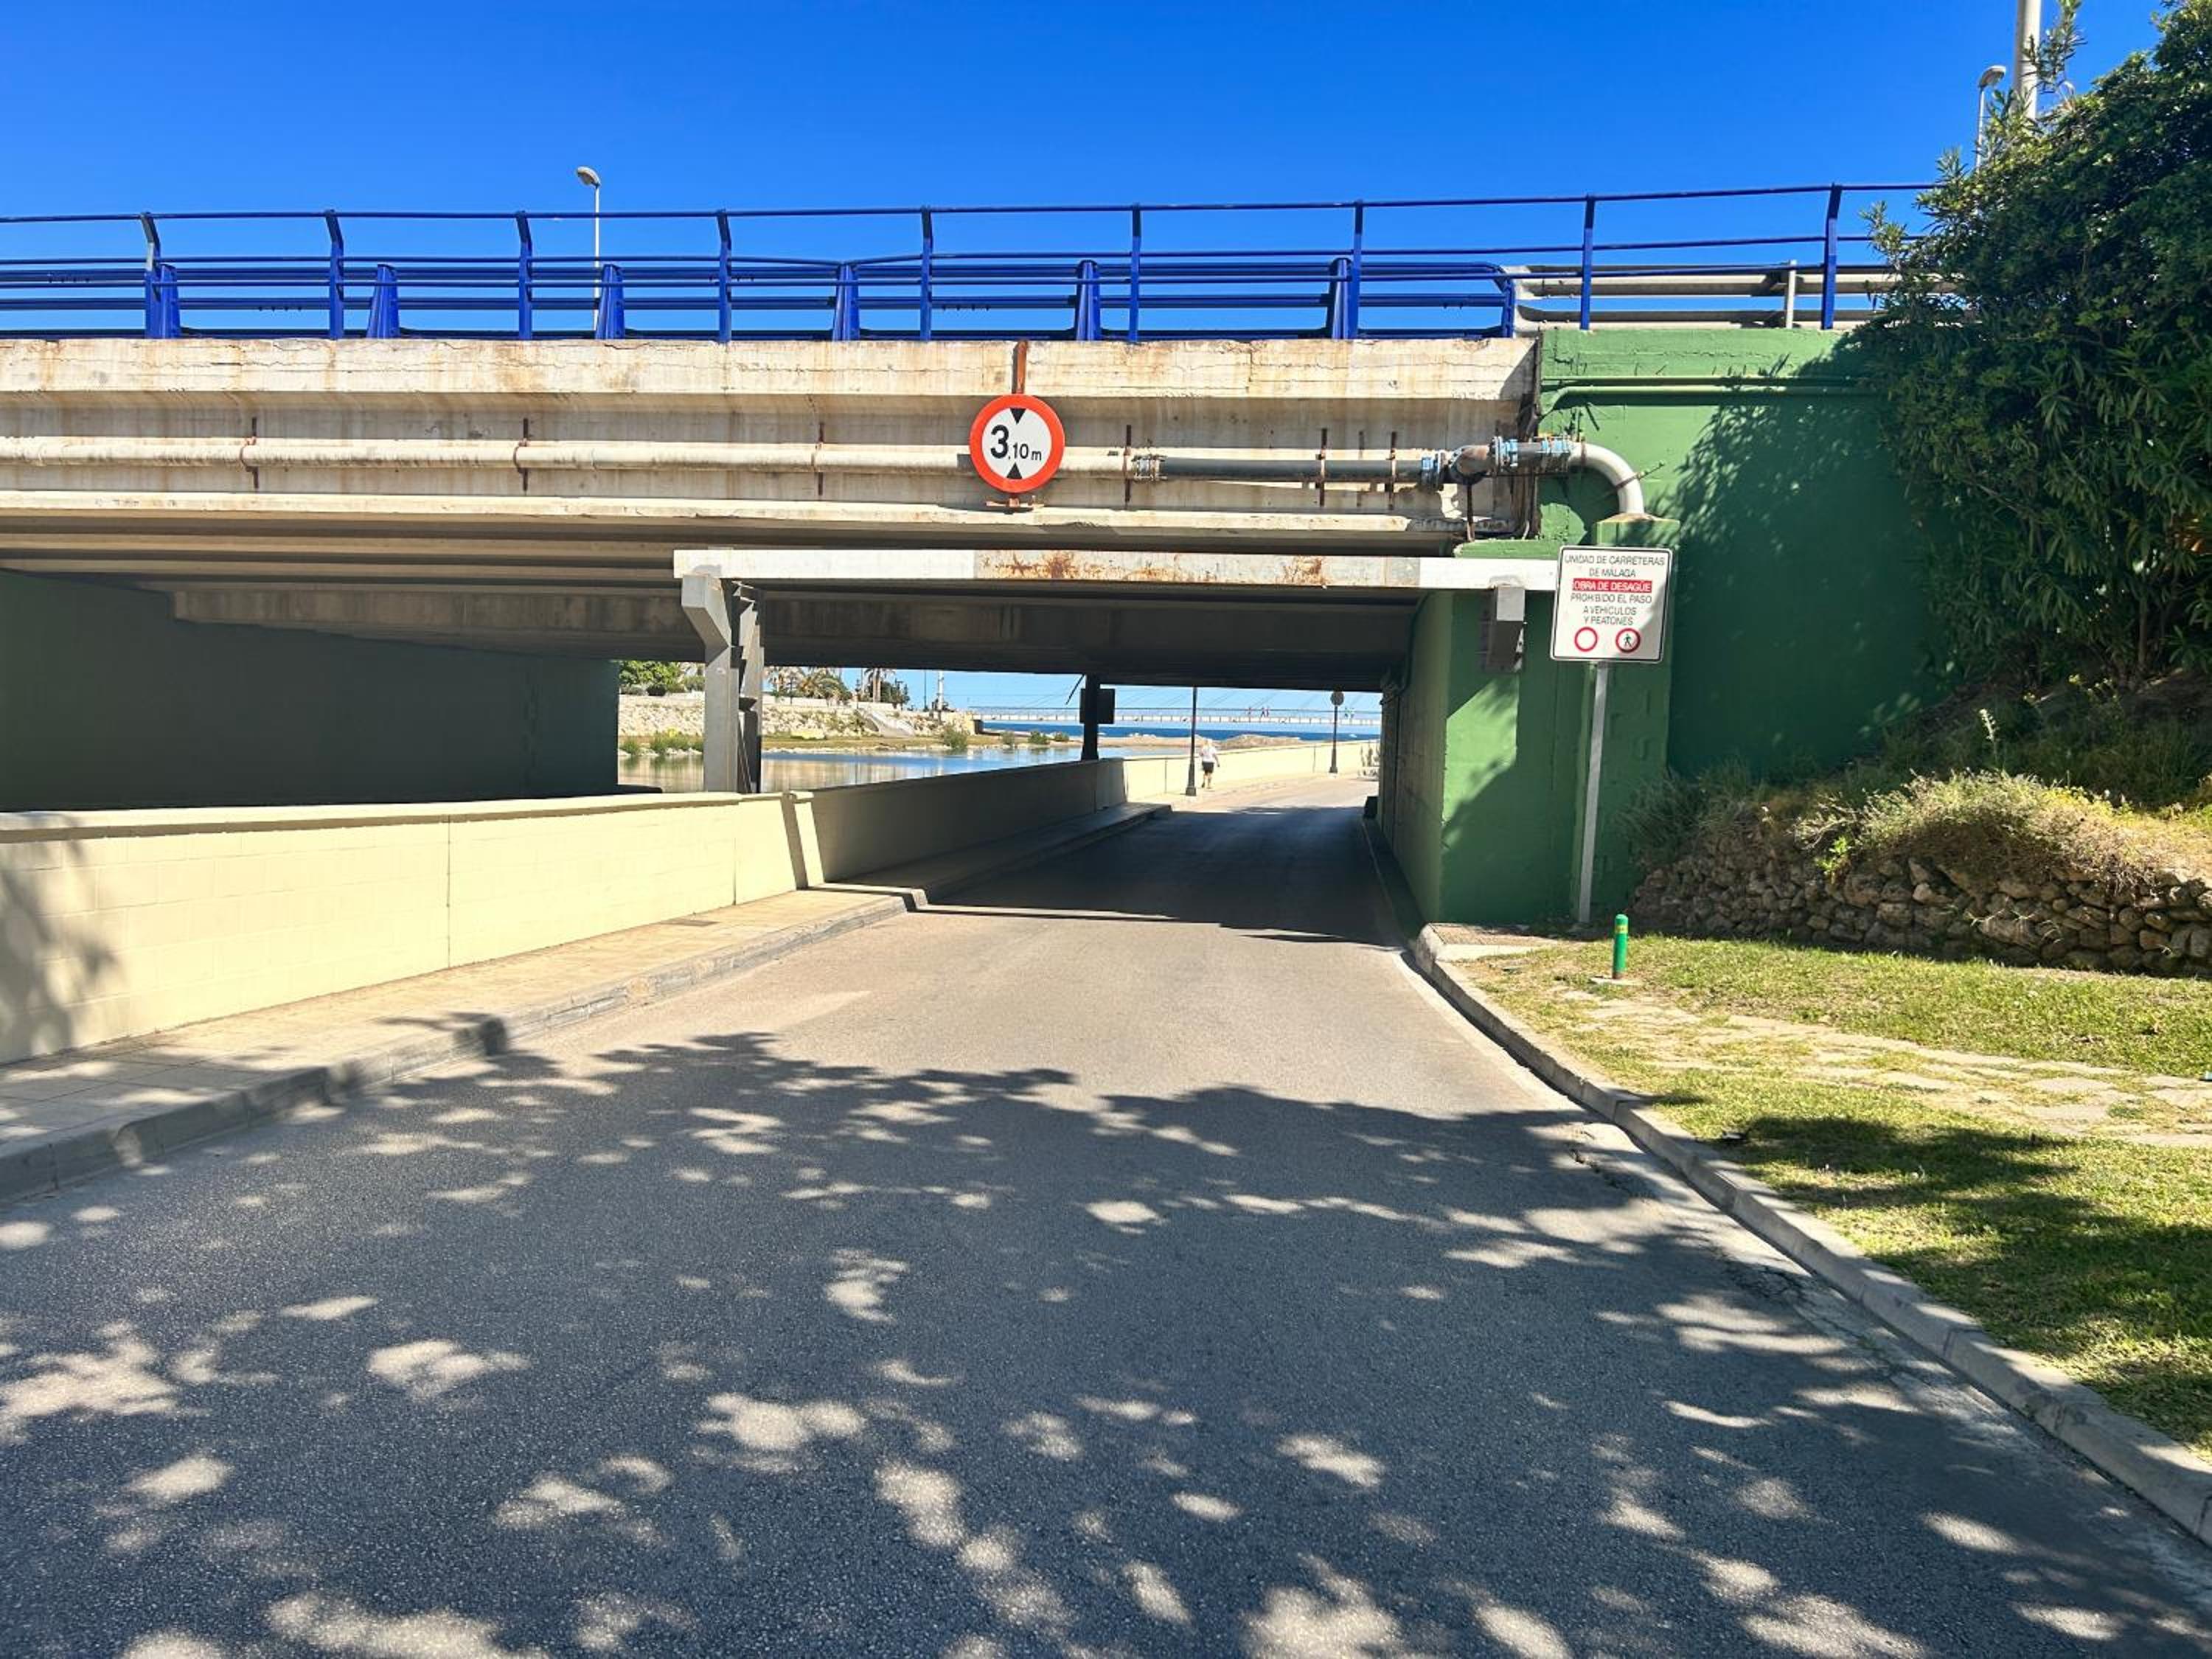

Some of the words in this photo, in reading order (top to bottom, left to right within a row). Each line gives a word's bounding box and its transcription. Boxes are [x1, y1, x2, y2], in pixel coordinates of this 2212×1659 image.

[1565, 554, 1595, 564] UNIDAD
[1596, 555, 1607, 564] DE
[1609, 555, 1665, 566] CARRETERAS
[1589, 568, 1601, 577] DE
[1574, 580, 1596, 591] OBRA
[1597, 581, 1610, 591] DE
[1610, 580, 1651, 592] DESAGÜE
[1571, 593, 1615, 602] PROHIBIDO
[1617, 594, 1627, 603] EL
[1629, 594, 1652, 604] PASO
[1582, 605, 1589, 614] A
[1583, 616, 1590, 624] Y
[1590, 616, 1634, 626] PEATONES
